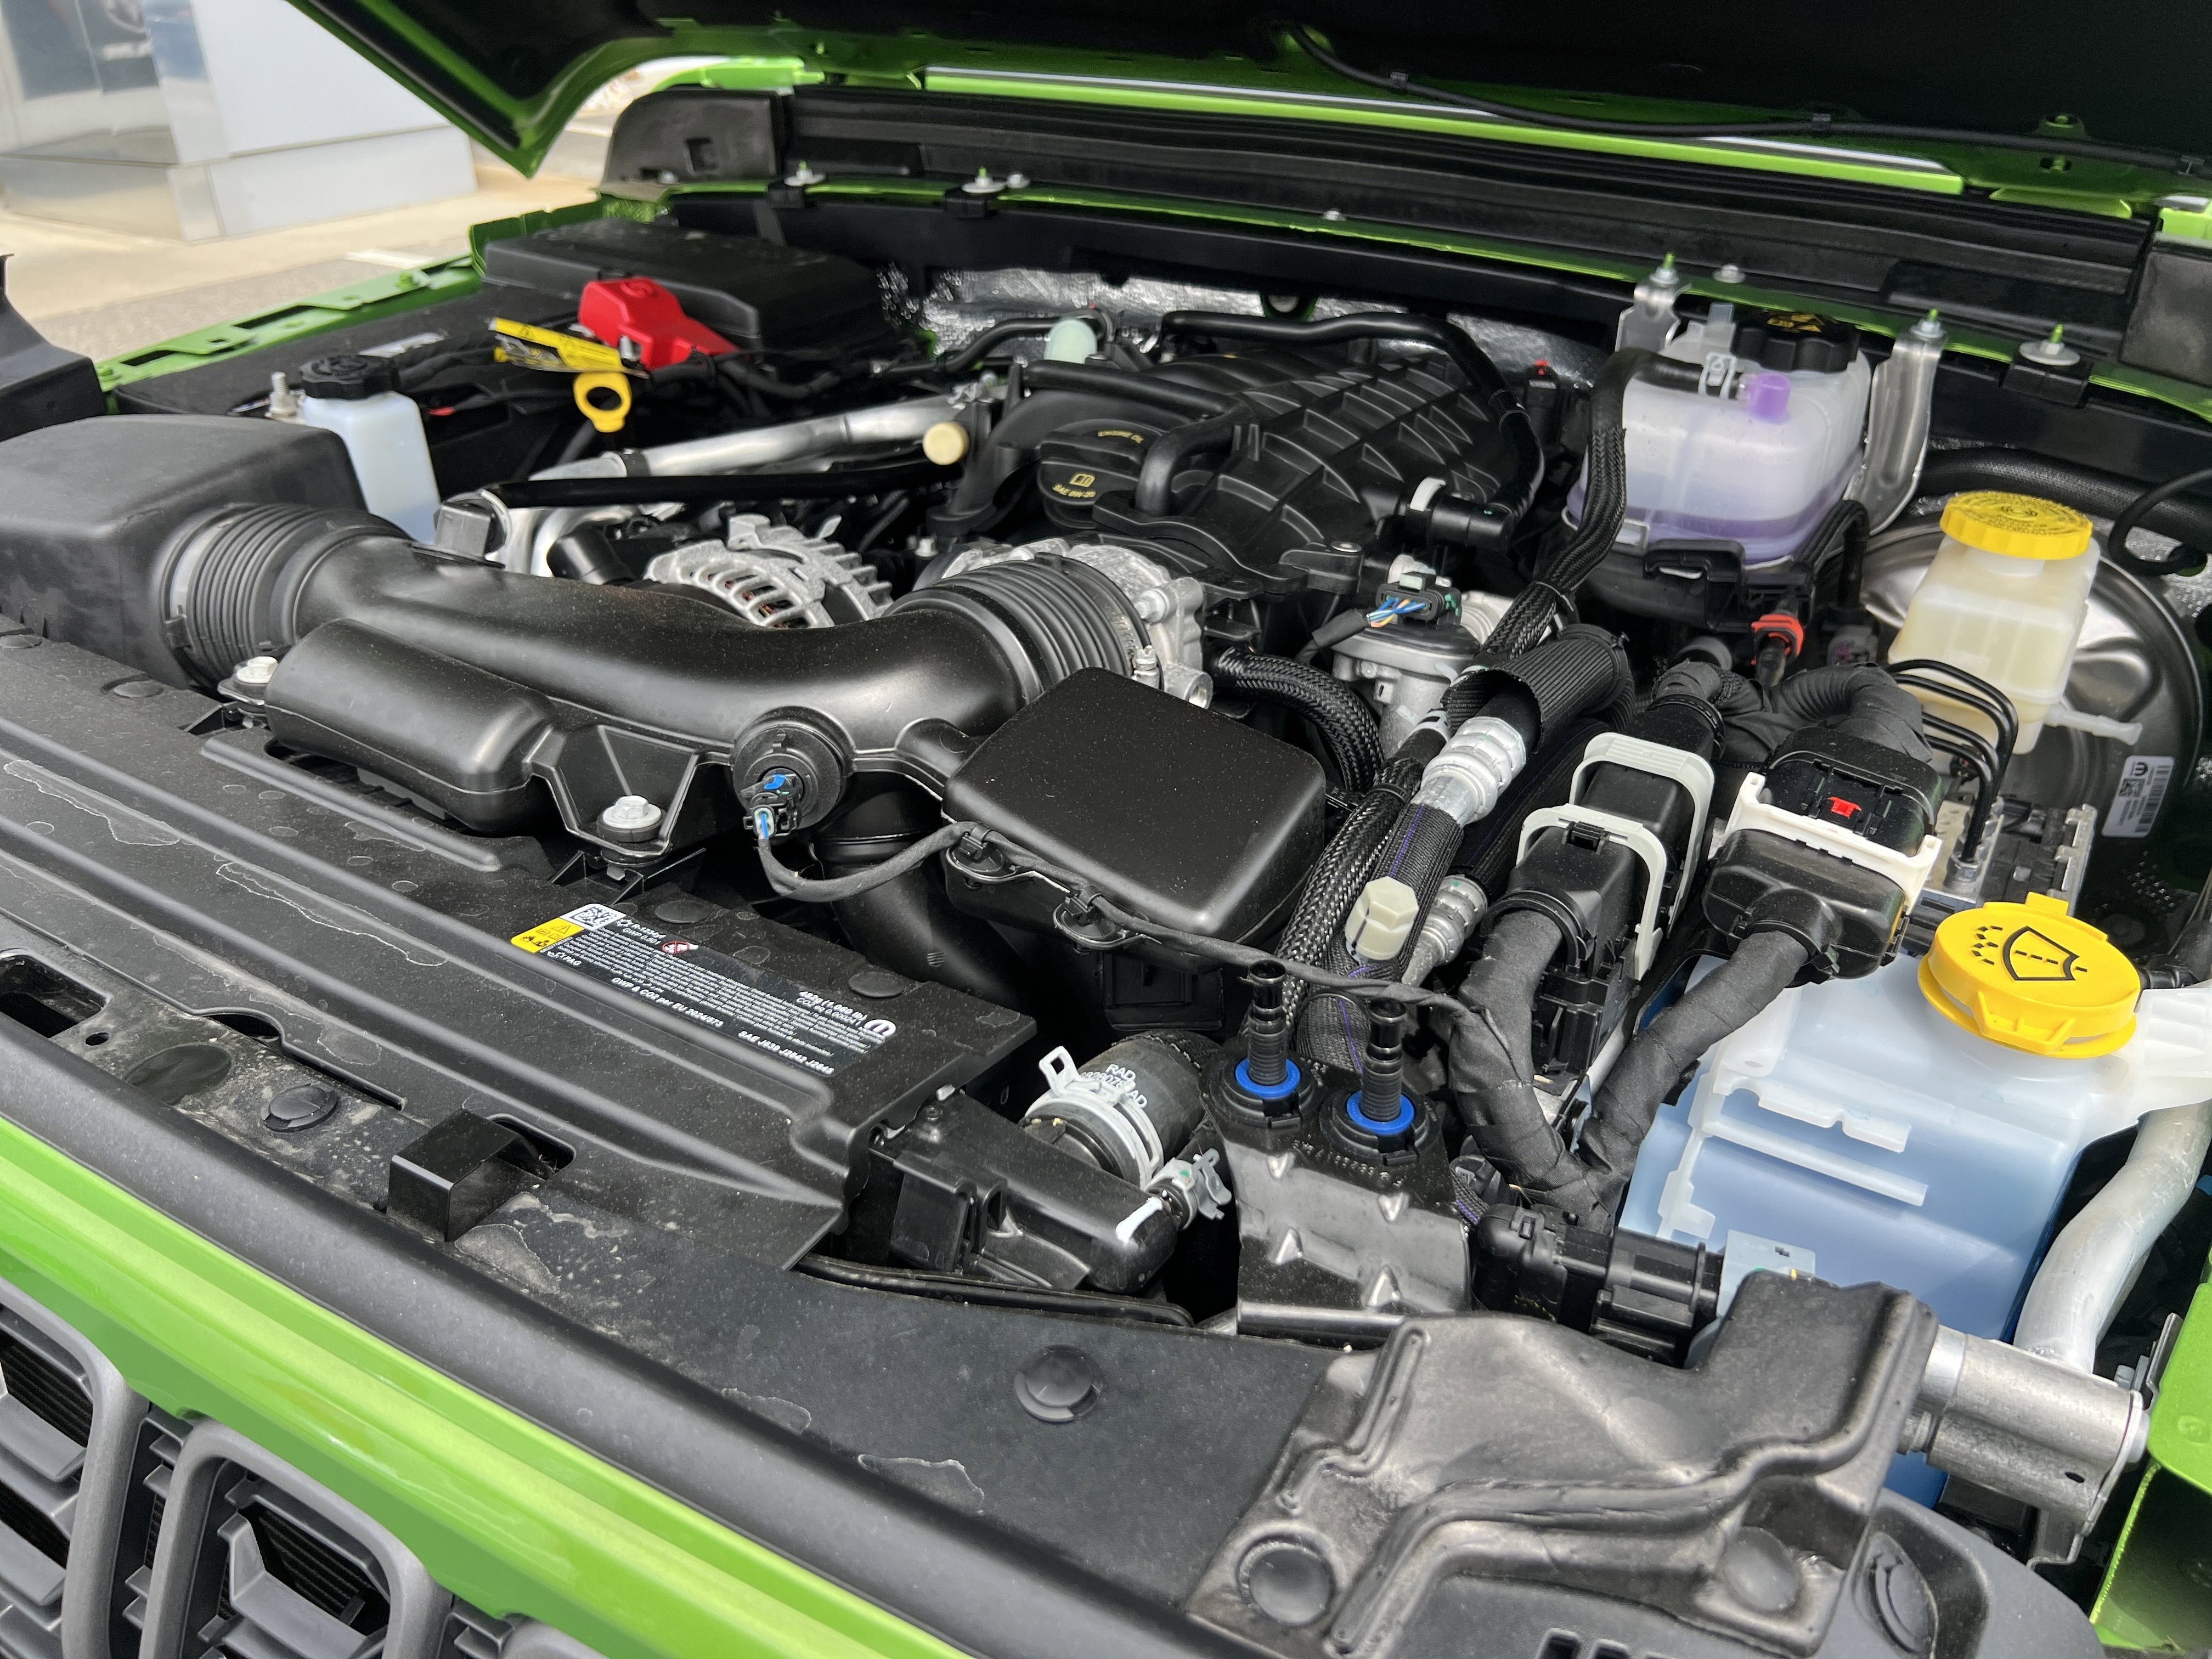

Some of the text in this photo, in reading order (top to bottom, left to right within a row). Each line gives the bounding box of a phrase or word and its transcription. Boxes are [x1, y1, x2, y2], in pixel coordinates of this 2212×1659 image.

[631, 924, 666, 939] R-1234yf
[640, 935, 661, 945] 0.501
[562, 956, 582, 966] PAG
[612, 977, 634, 987] GWP
[640, 989, 659, 1000] CO2
[656, 997, 674, 1006] per
[672, 1002, 688, 1012] EU
[685, 1008, 724, 1028] 2024/573
[738, 1030, 760, 1043] SAE
[1106, 1064, 1136, 1081] RAD
